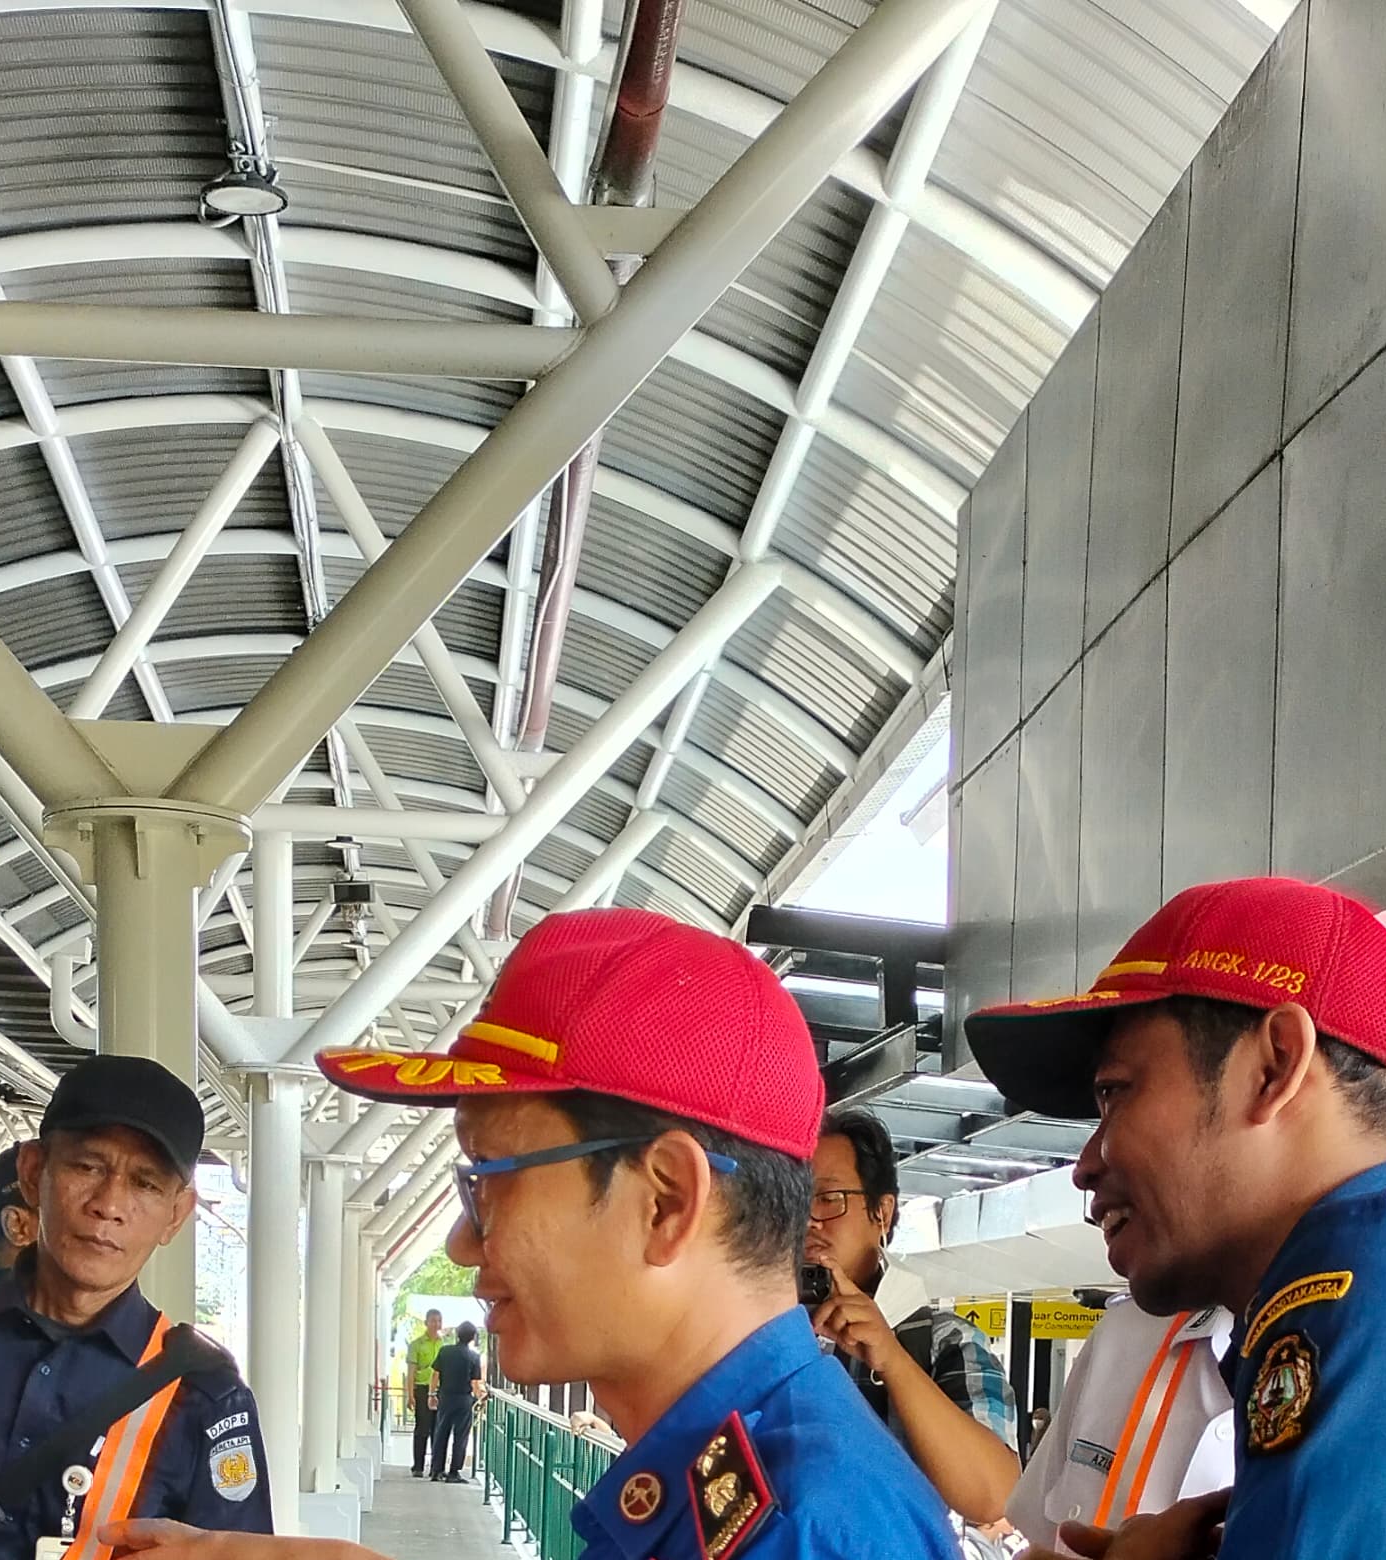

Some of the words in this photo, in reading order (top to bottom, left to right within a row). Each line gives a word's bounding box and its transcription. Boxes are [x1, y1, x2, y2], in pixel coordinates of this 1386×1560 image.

[1180, 949, 1248, 977] ANGK.
[209, 1417, 237, 1438] DAOP
[240, 1414, 247, 1424] 6
